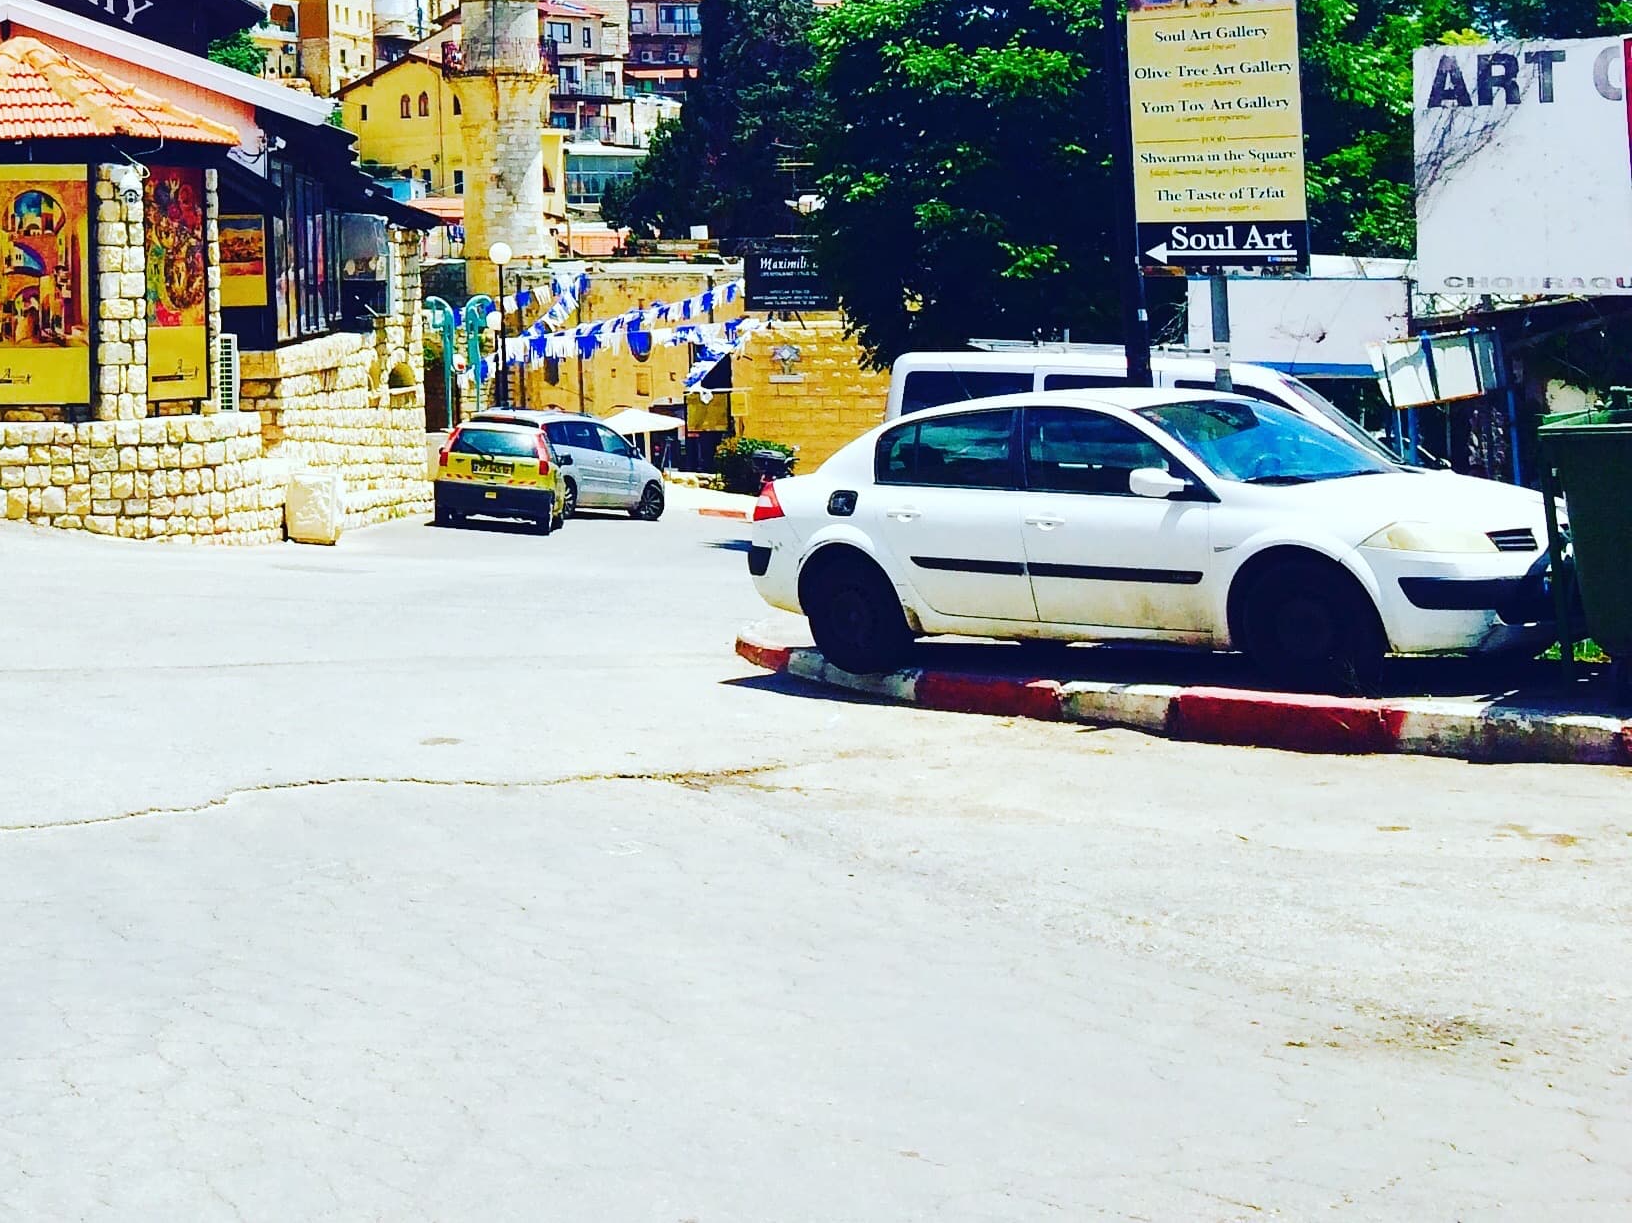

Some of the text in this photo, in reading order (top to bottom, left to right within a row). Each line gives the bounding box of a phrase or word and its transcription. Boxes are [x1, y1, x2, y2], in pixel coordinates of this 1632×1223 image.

[1154, 26, 1270, 43] Soul Art Gallery
[1134, 60, 1293, 79] Olive Tree Art Gallery
[1427, 49, 1566, 108] ART
[1141, 96, 1290, 114] Yom Tov Art Gallery
[1140, 149, 1297, 164] Shwarma in the Square
[1155, 186, 1286, 201] The Taste of Tzfat
[1171, 224, 1293, 250] Soul Art
[759, 255, 819, 271] Maximili
